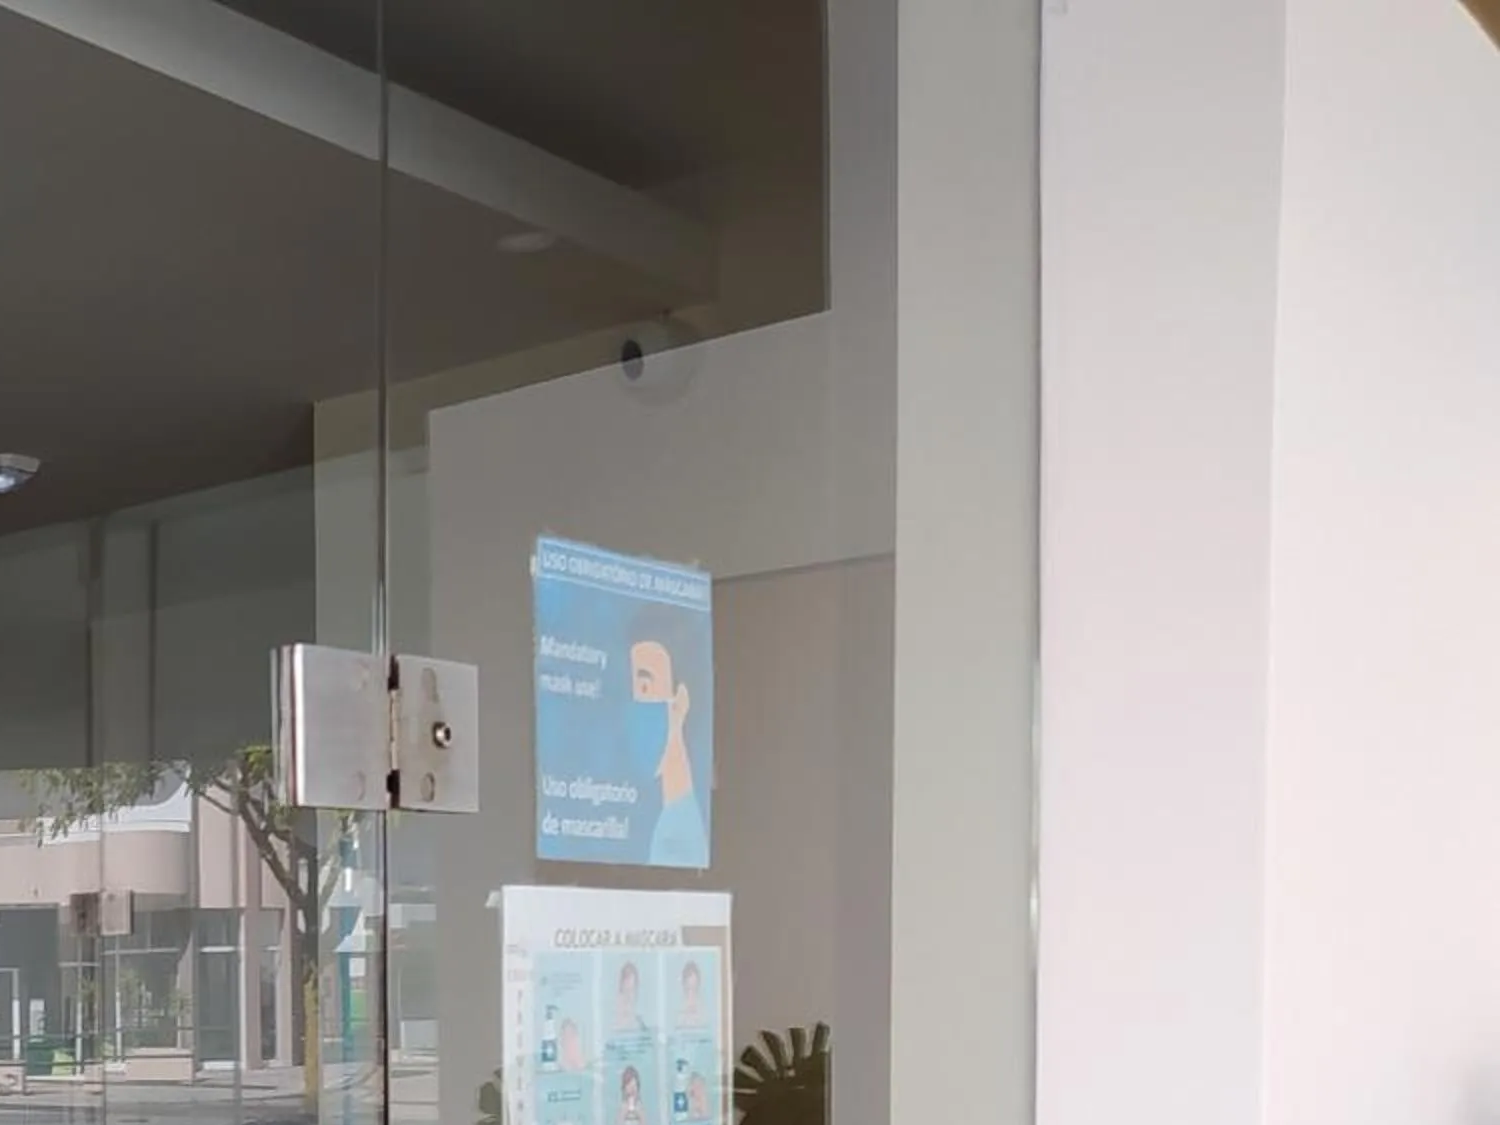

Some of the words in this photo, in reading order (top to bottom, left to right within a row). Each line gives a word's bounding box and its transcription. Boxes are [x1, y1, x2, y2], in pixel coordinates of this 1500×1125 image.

[543, 552, 567, 572] USO
[541, 635, 607, 670] Mandatory
[542, 776, 567, 799] Uso
[542, 809, 560, 836] de
